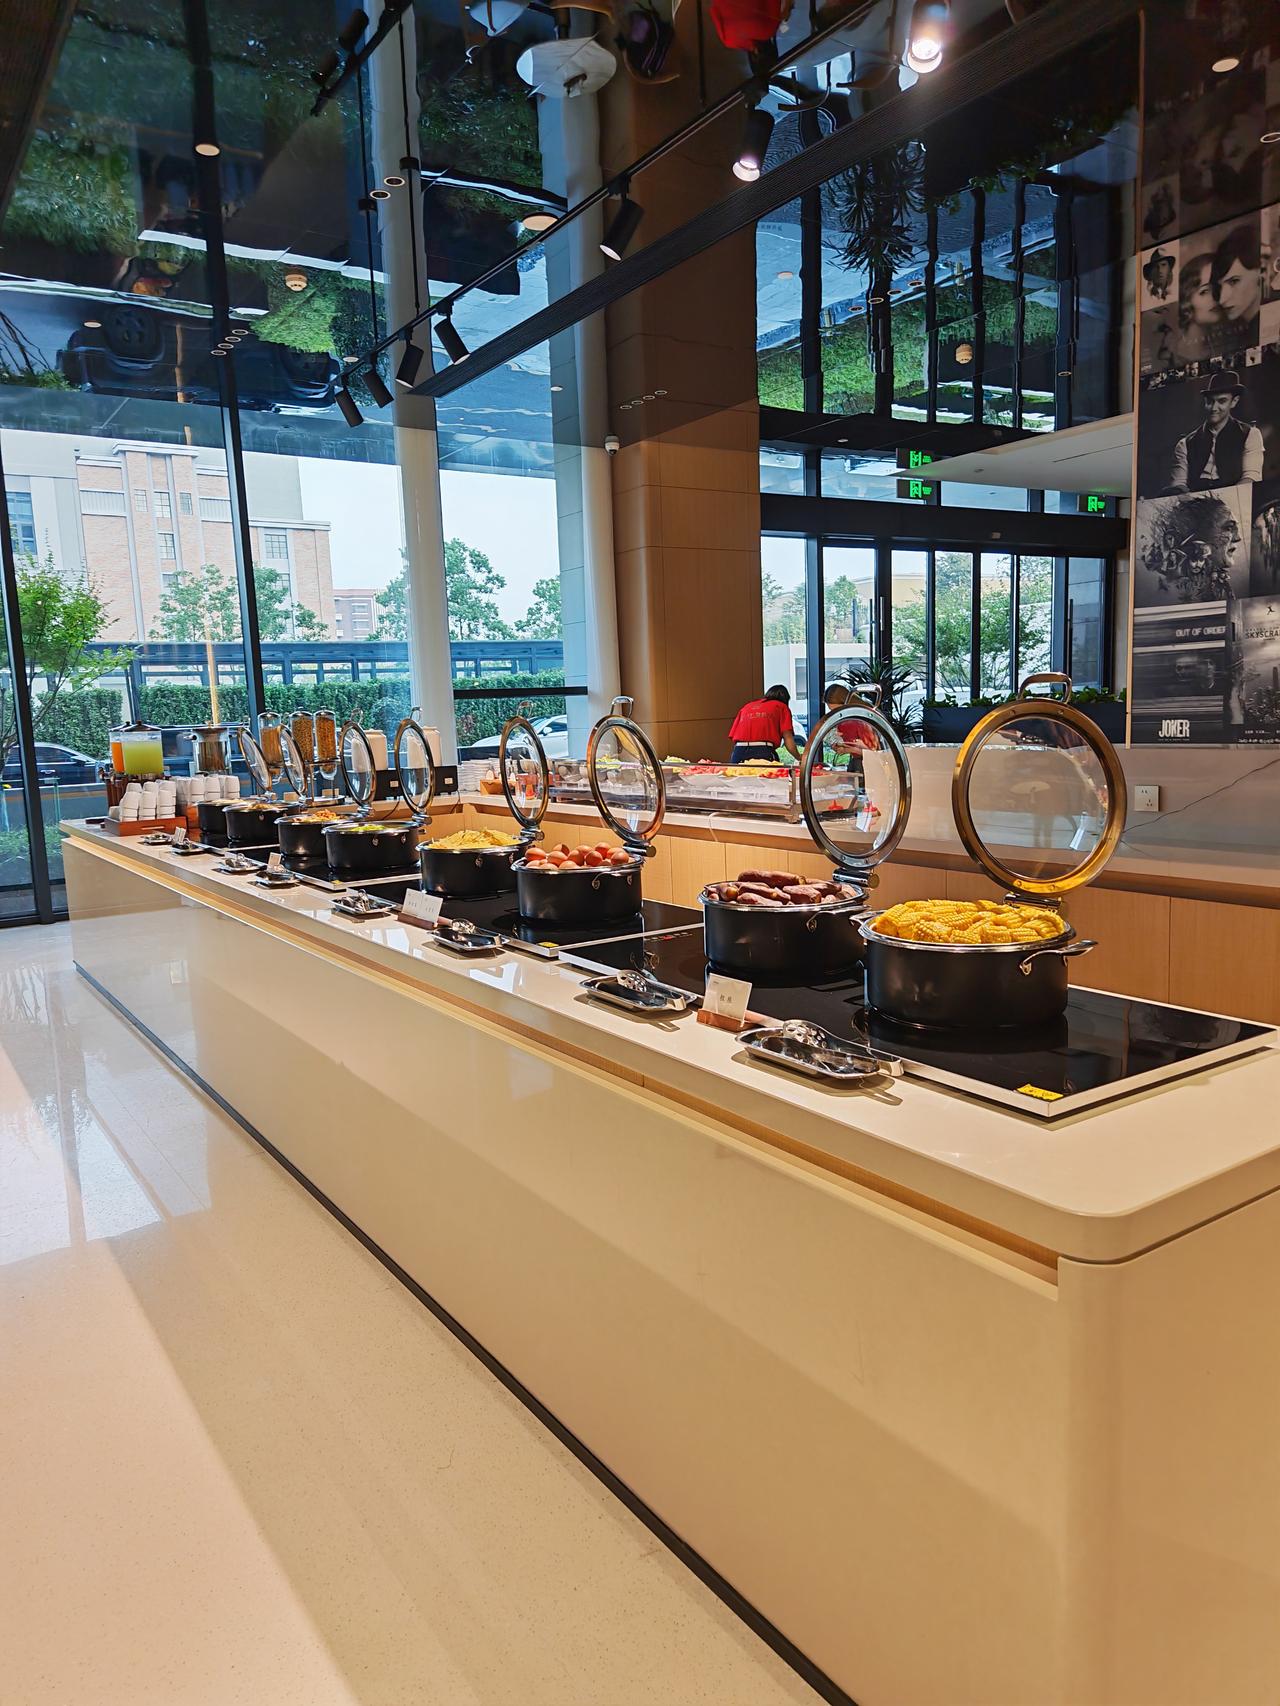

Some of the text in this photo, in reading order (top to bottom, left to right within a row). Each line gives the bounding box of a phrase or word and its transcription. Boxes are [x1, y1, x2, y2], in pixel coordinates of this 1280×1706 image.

[1176, 628, 1190, 637] OUT
[1192, 627, 1202, 636] OF
[1159, 720, 1190, 737] JOKER
